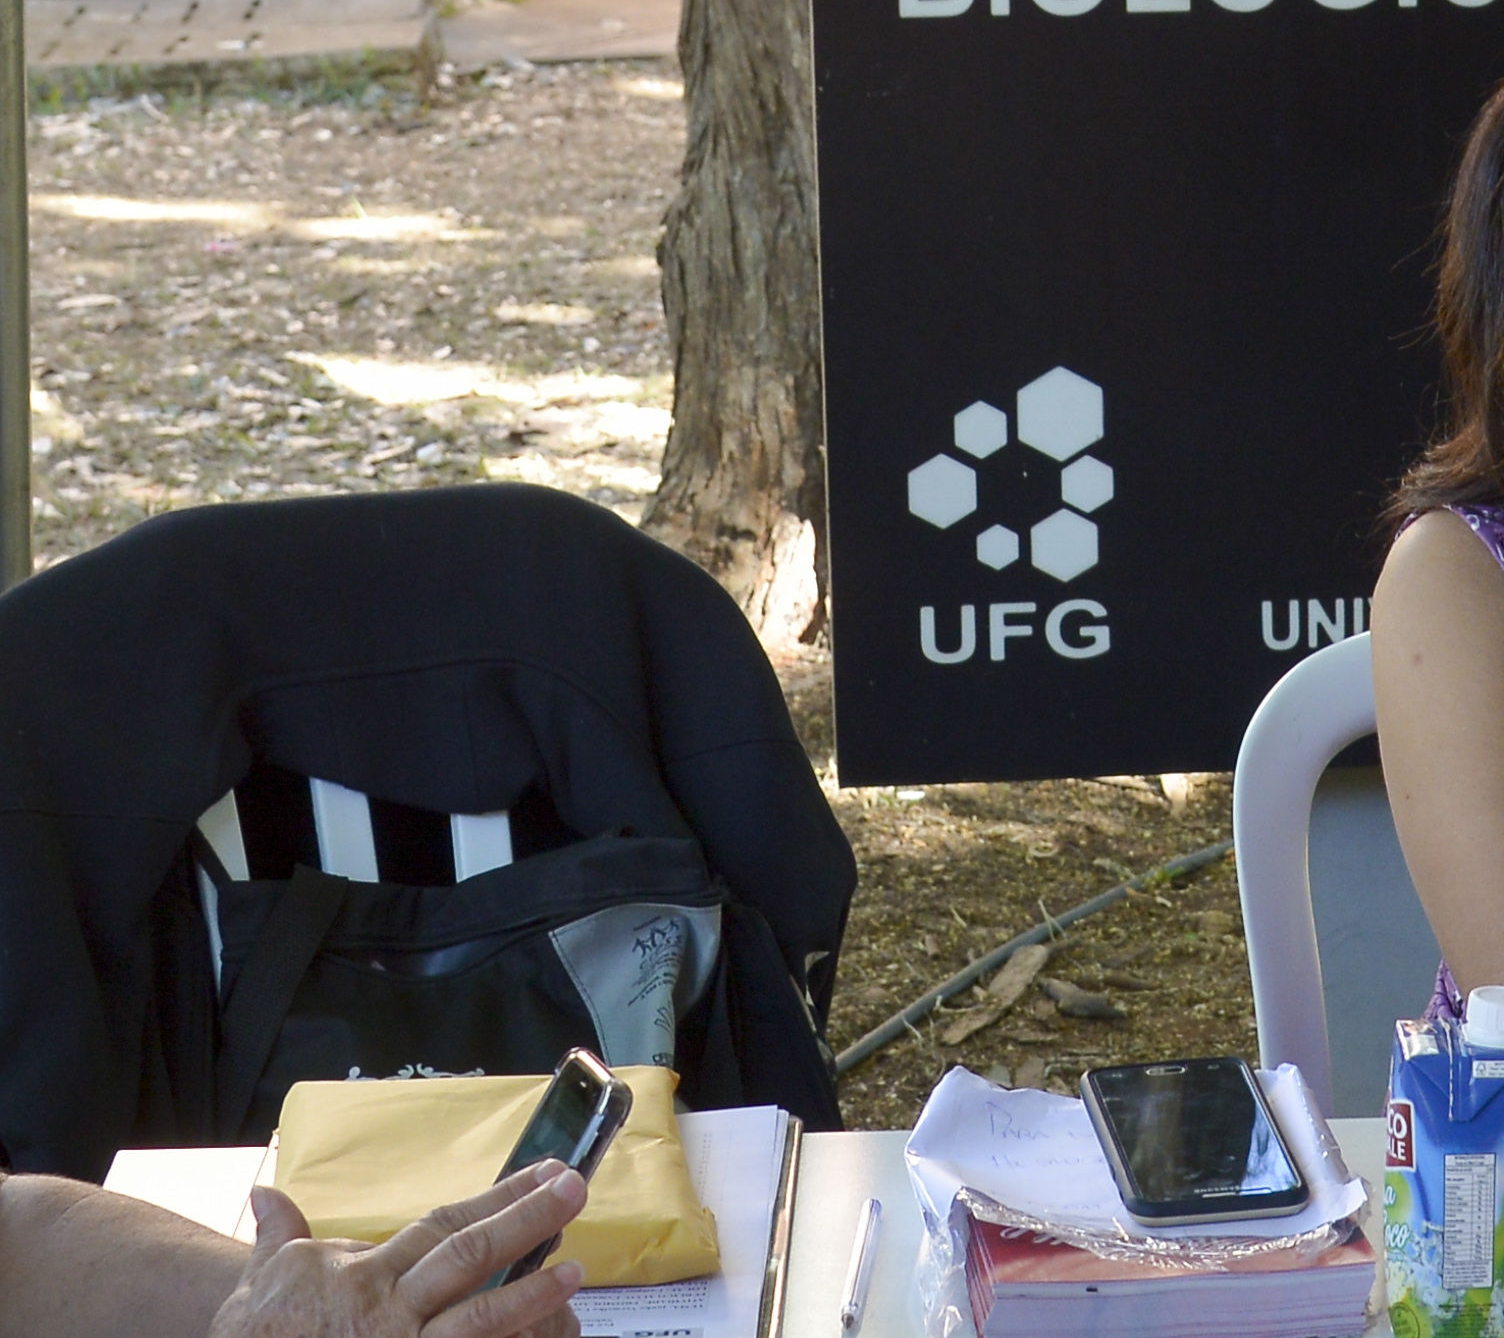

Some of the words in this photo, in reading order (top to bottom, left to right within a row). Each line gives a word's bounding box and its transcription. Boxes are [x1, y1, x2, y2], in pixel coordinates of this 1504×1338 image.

[919, 598, 1111, 663] UFG
[1261, 596, 1372, 651] UNI
[634, 1328, 691, 1337] UFG
